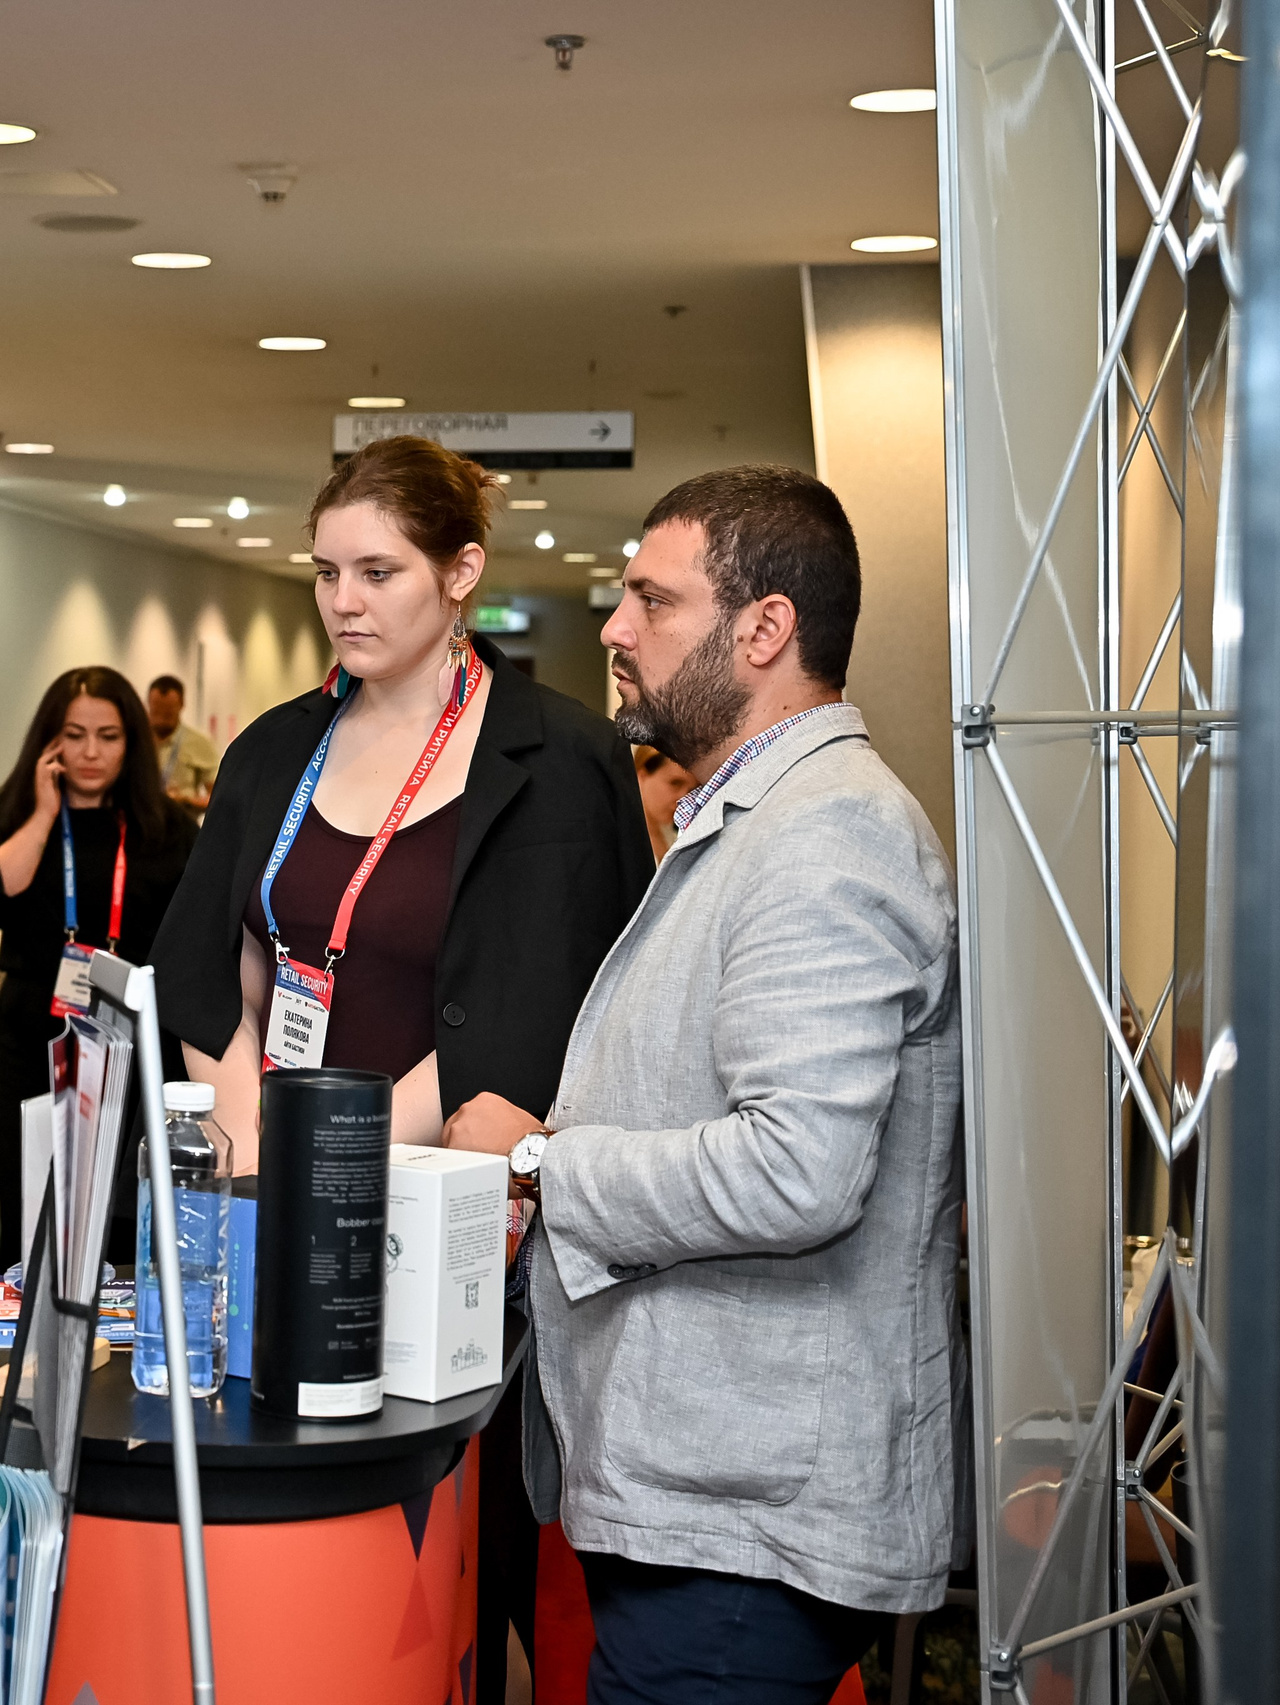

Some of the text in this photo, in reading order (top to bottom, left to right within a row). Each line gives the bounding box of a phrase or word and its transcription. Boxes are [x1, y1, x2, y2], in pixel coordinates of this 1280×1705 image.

[409, 728, 449, 786] РИТЕЙЛА
[265, 776, 314, 880] RETAIL SECURITY
[348, 793, 411, 895] RETAIL SECURITY
[280, 966, 300, 985] RETAIL
[300, 974, 328, 995] SECURITY
[284, 1009, 313, 1030] ЕКАТЕРИНА
[330, 1115, 356, 1124] What
[357, 1115, 365, 1124] is
[336, 1217, 369, 1228] Bobber
[350, 1234, 358, 1247] 2
